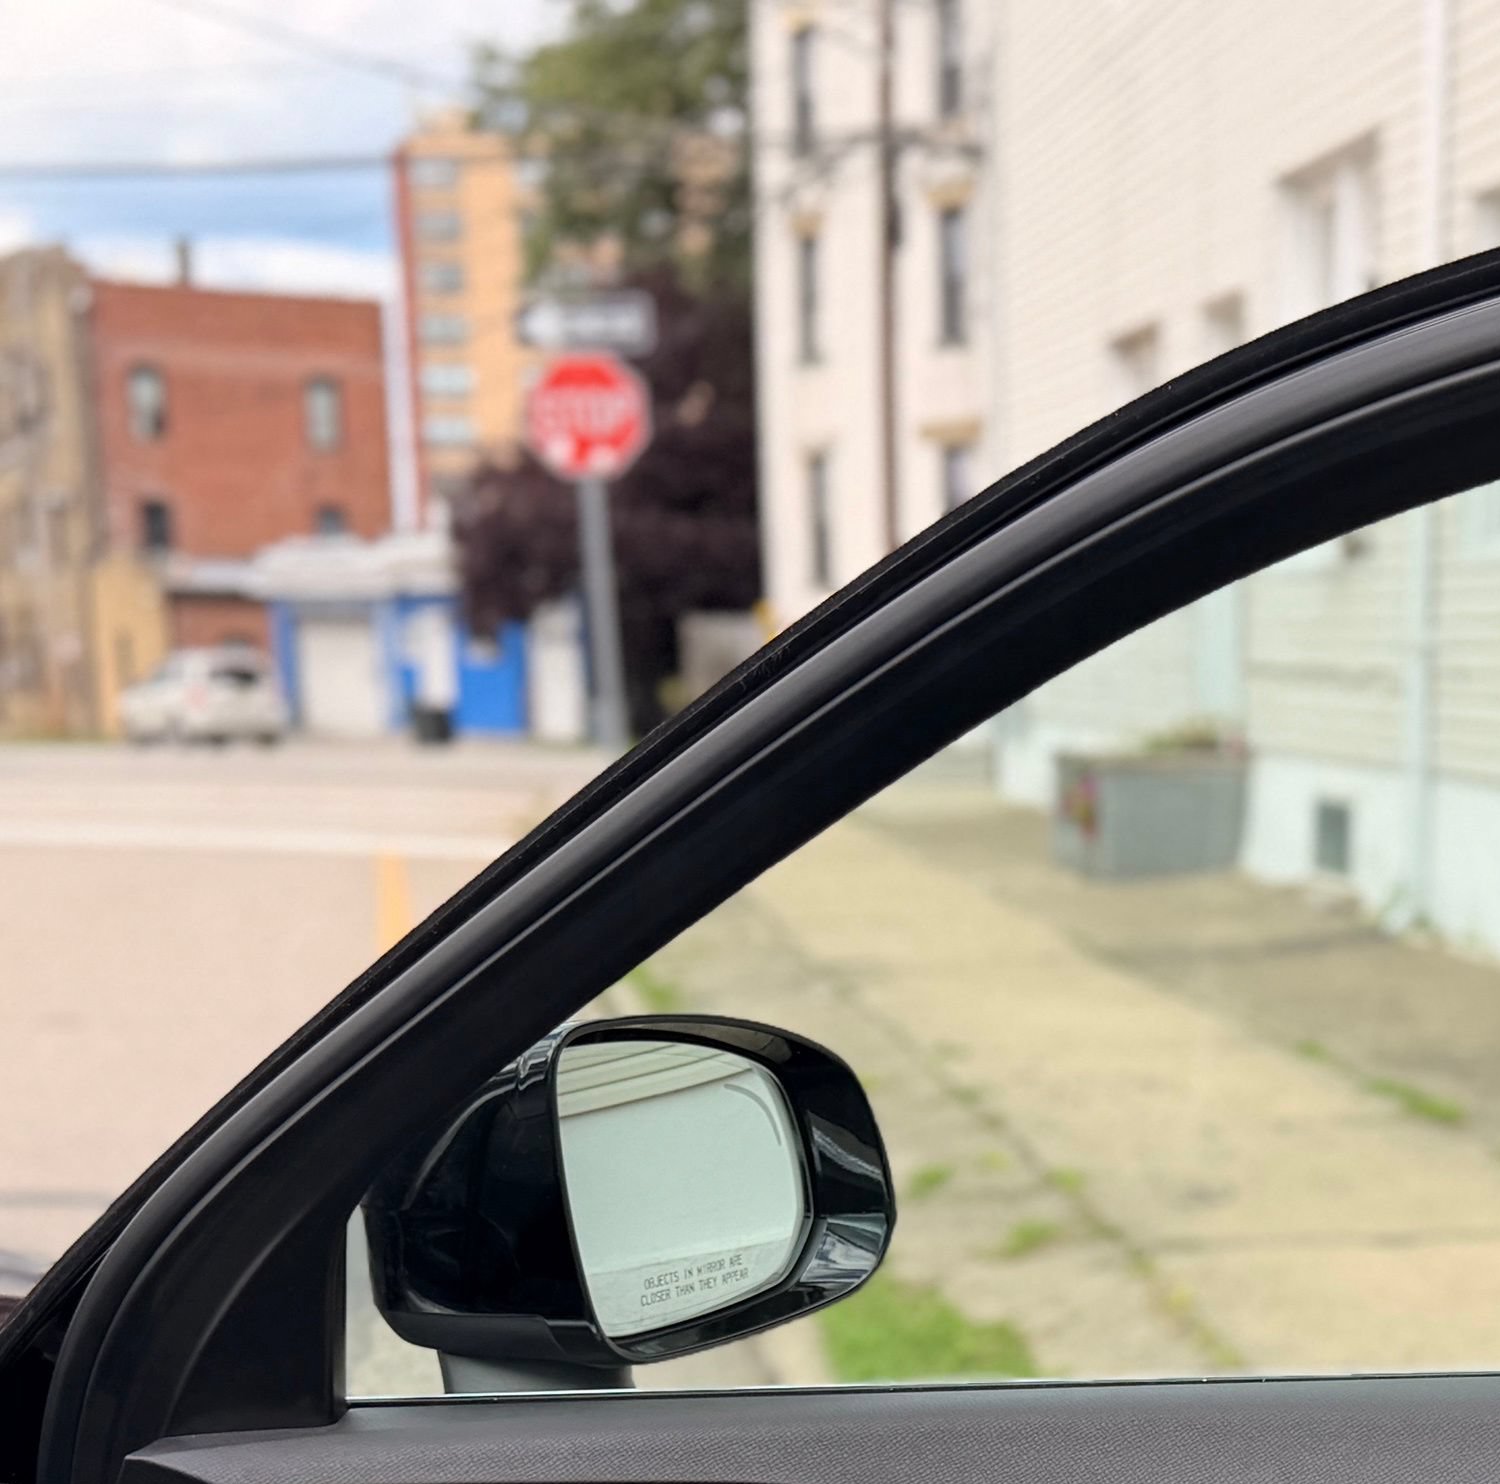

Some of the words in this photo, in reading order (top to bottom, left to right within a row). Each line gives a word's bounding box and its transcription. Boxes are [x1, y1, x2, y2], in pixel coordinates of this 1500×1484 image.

[640, 1290, 672, 1307] CLOSER
[675, 1283, 695, 1298] THAN
[699, 1278, 717, 1291] THEY
[721, 1268, 749, 1286] APPEAR
[644, 1271, 679, 1291] OBJECTS
[684, 1267, 694, 1279] IN
[697, 1258, 726, 1275] MIRROR
[729, 1254, 743, 1267] ARE
